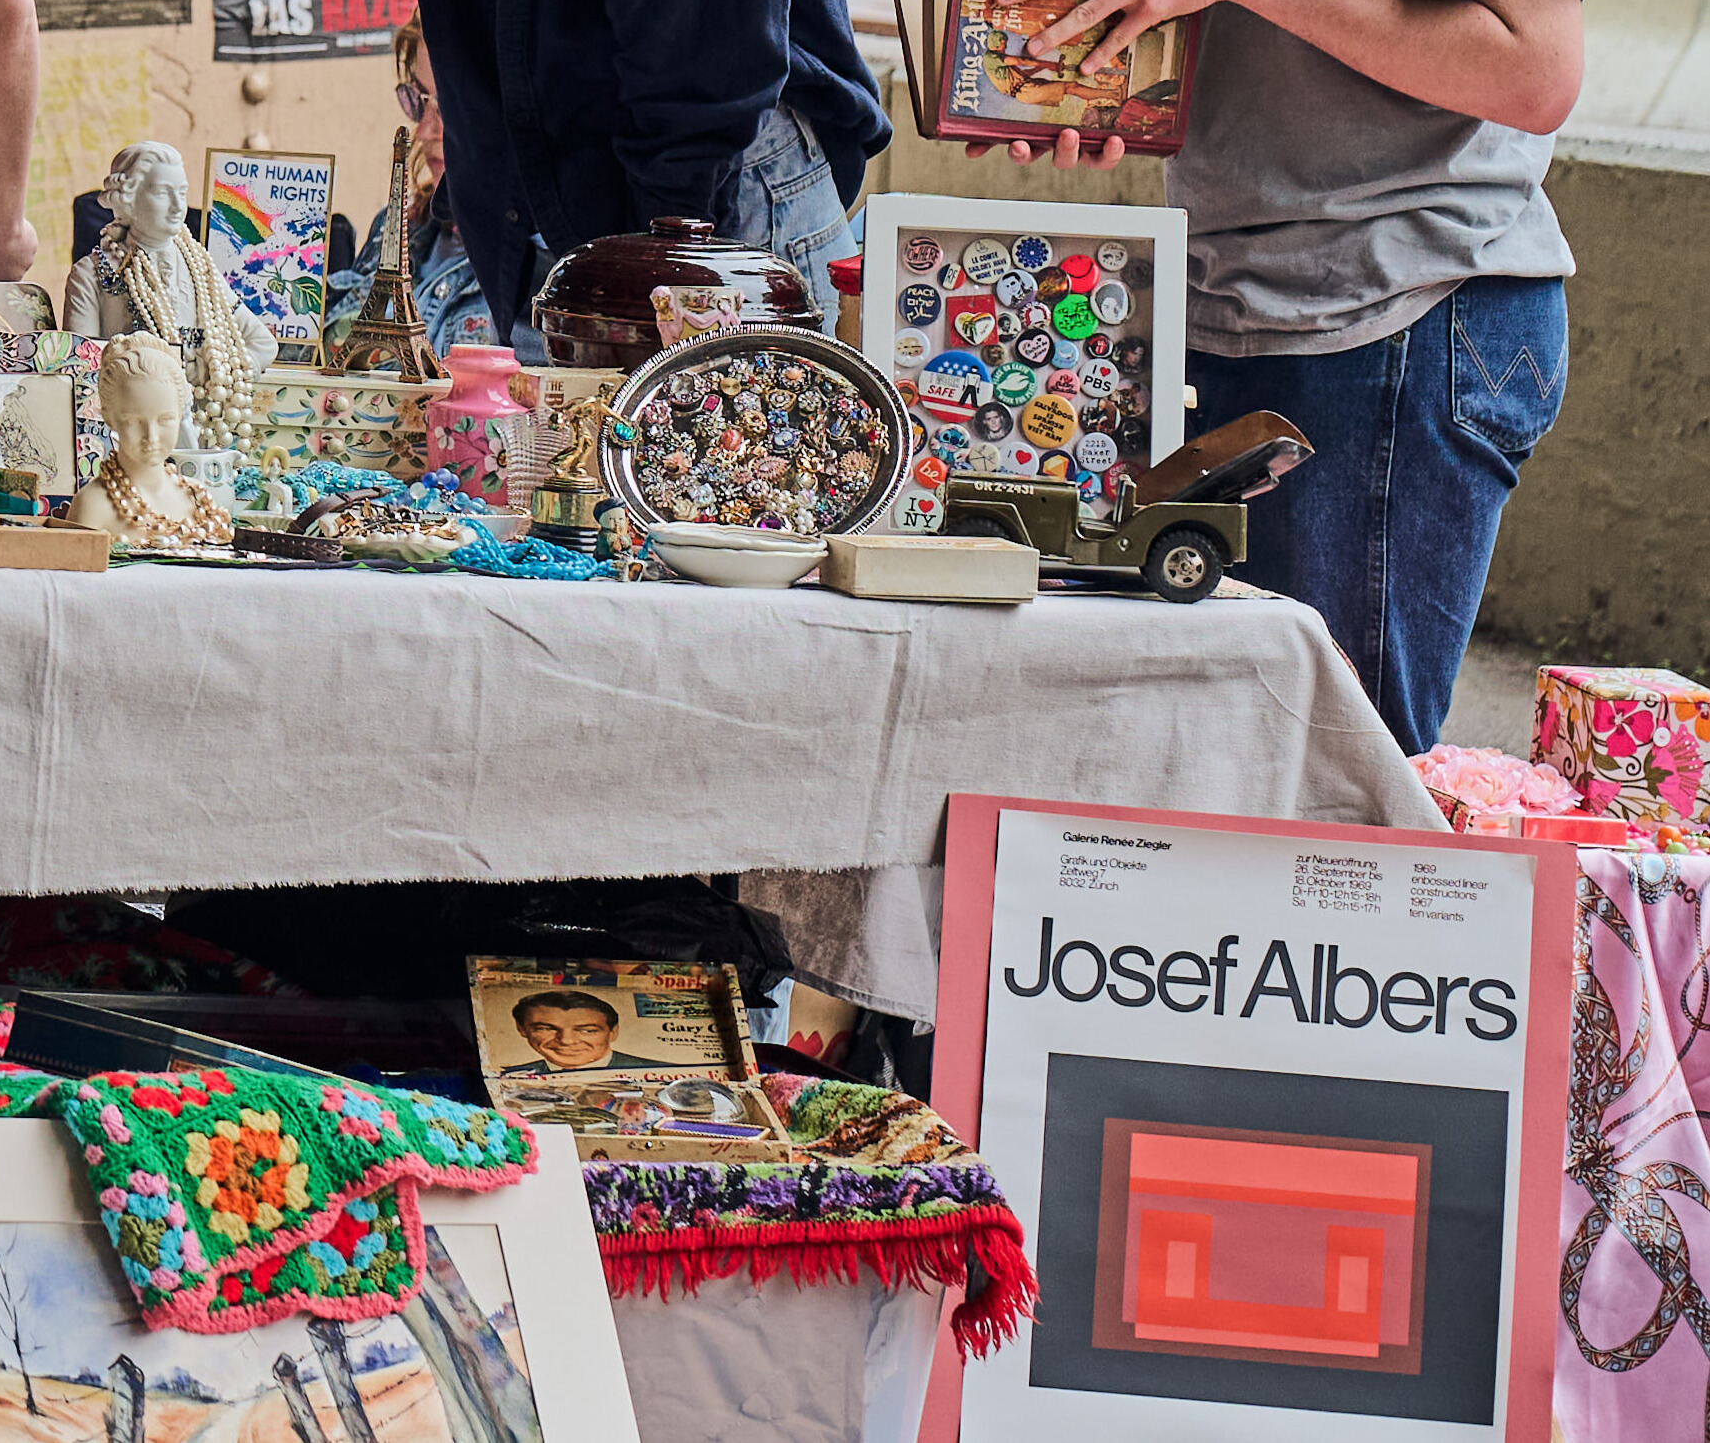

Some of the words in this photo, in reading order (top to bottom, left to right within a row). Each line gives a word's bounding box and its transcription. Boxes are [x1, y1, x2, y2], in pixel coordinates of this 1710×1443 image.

[224, 161, 259, 178] OUR
[265, 165, 328, 184] HUMAN
[270, 185, 326, 203] RIGHTS
[907, 287, 935, 297] PEACE
[1084, 375, 1112, 392] PBS
[927, 384, 956, 398] SAFE
[1033, 414, 1064, 431] SPANISH
[1082, 448, 1111, 456] Baker
[919, 460, 939, 479] be
[908, 497, 917, 511] I
[903, 511, 937, 529] NY
[1063, 832, 1099, 844] Galerie
[1101, 835, 1134, 847] Renée
[1136, 838, 1172, 851] Ziegler
[1060, 854, 1089, 866] Grafik
[1089, 858, 1108, 867] und
[1109, 857, 1147, 871] Objekte
[1296, 855, 1311, 863] zur
[1060, 866, 1099, 879] Zeltweg
[1100, 868, 1107, 878] 7
[1294, 863, 1309, 874] 26.
[1312, 864, 1367, 879] September
[1368, 870, 1383, 881] bis
[1414, 863, 1437, 875] 1969
[1059, 877, 1086, 889] 8032
[1088, 877, 1119, 891] Zürich
[1306, 875, 1346, 888] Oktober
[1349, 879, 1372, 891] 1969
[1462, 878, 1489, 890] linear
[1410, 887, 1478, 901] constructions
[1292, 896, 1306, 908] Sa
[1410, 897, 1433, 908] 1967
[1409, 908, 1425, 918] ten
[1426, 910, 1464, 922] variants
[1003, 916, 1239, 1016] Josef
[1239, 939, 1518, 1042] Albers
[662, 1022, 704, 1035] Gary
